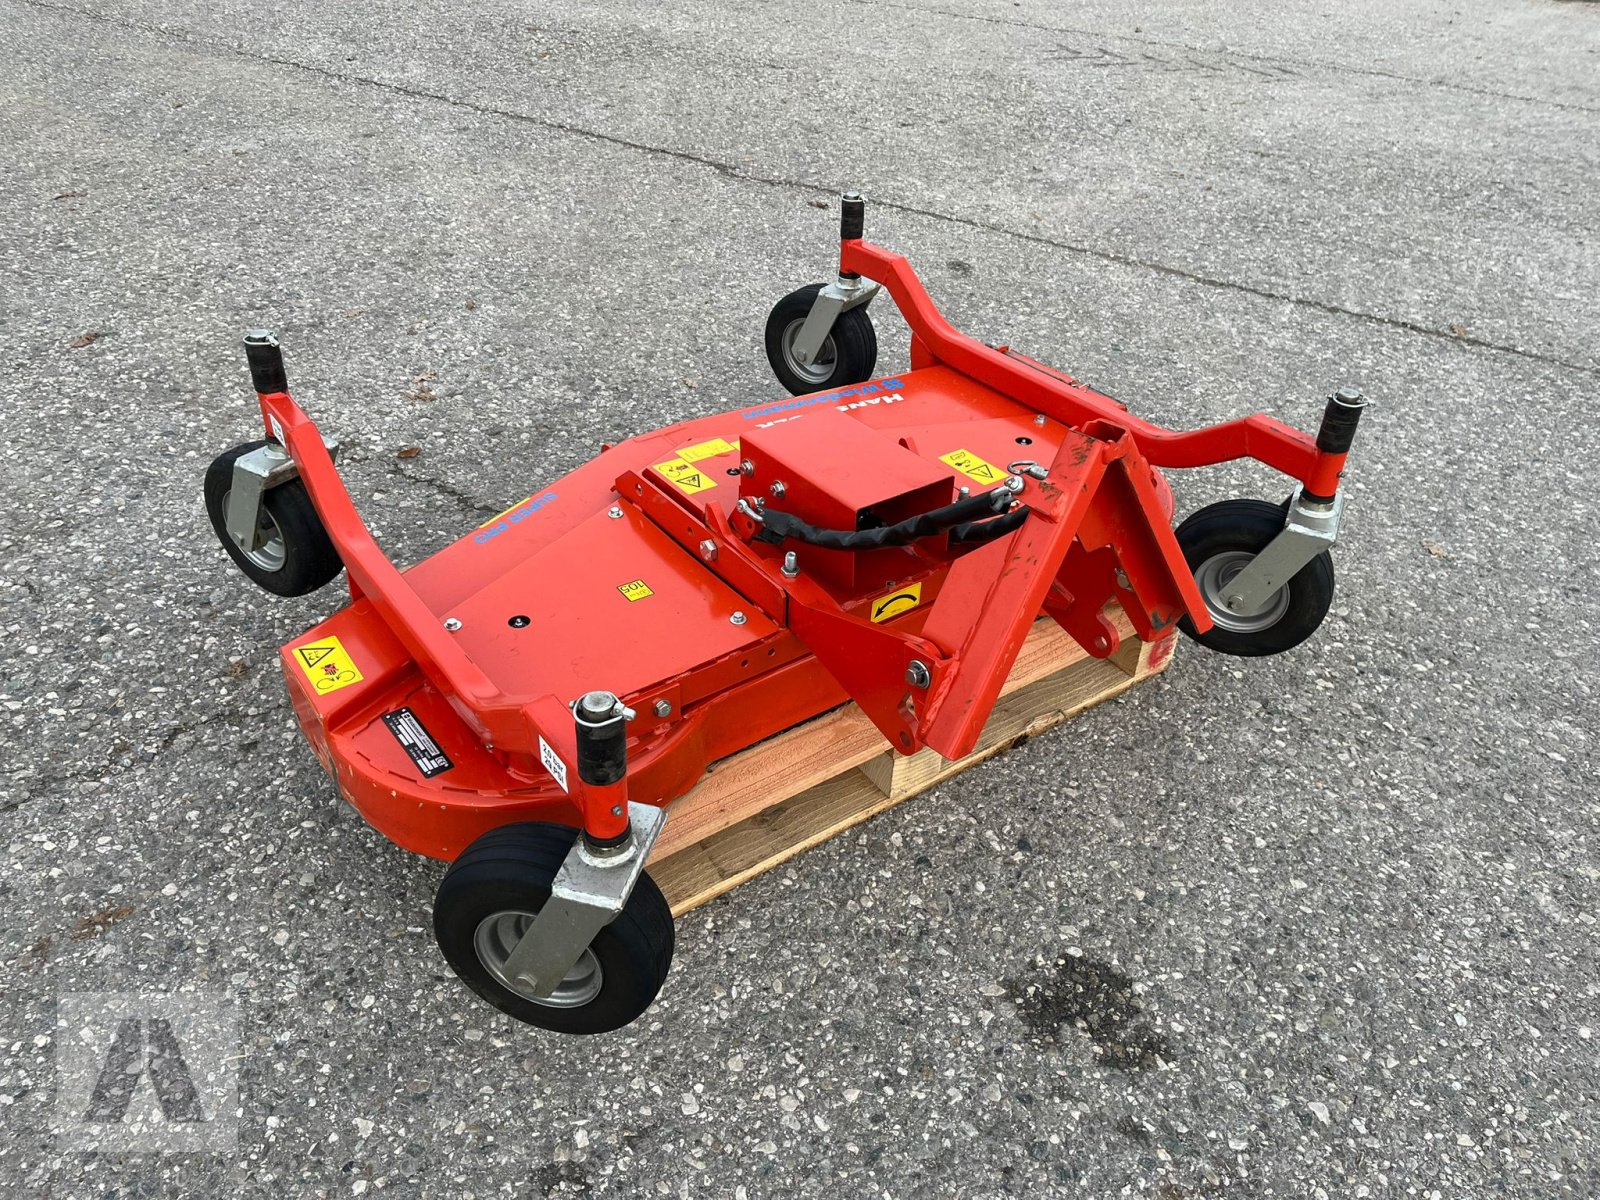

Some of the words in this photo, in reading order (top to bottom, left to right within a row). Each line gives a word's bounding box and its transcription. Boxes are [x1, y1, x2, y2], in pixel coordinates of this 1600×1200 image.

[507, 492, 558, 524] SUPER
[474, 521, 509, 544] PRO
[620, 581, 644, 594] 105
